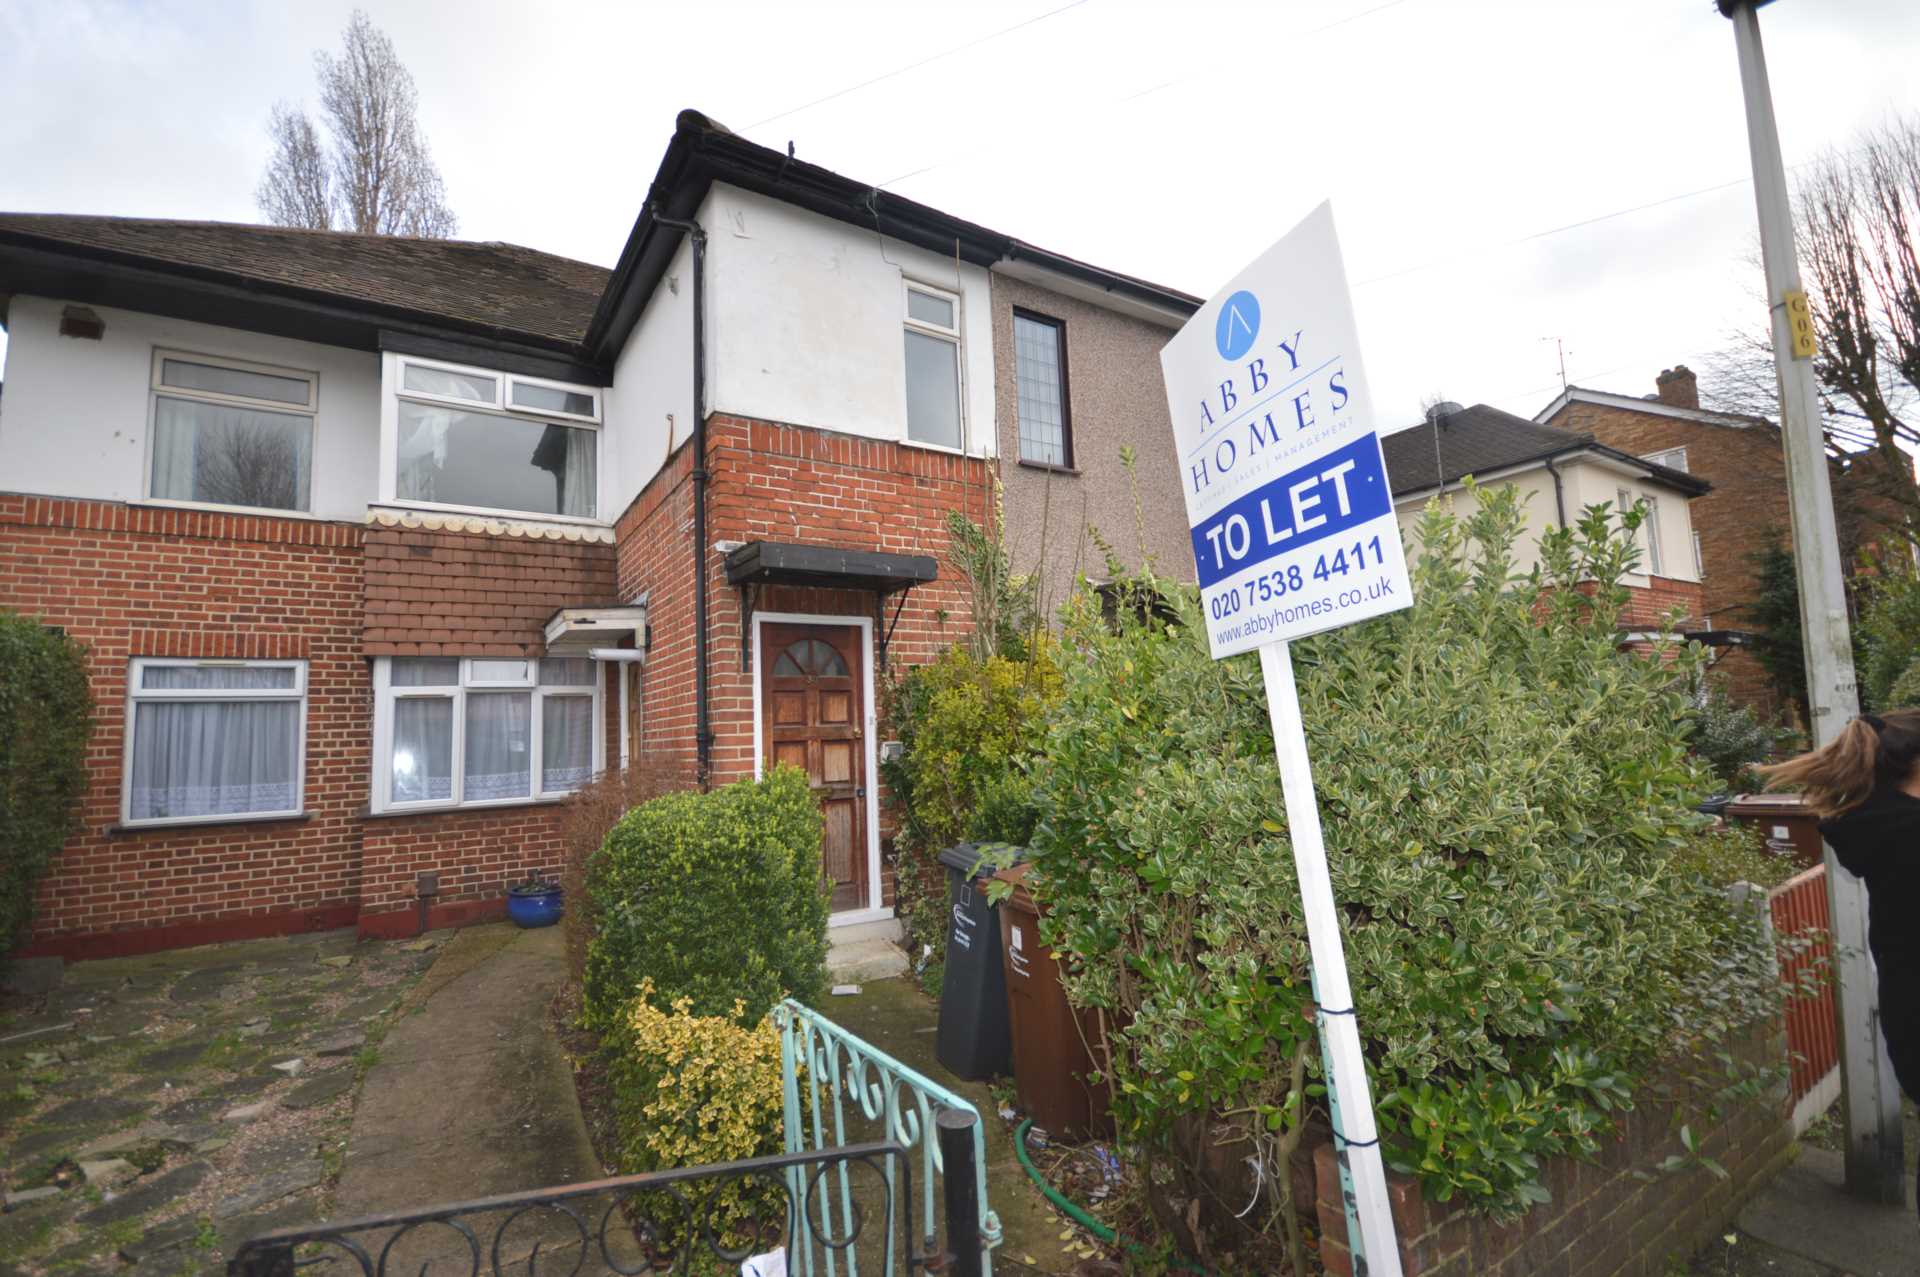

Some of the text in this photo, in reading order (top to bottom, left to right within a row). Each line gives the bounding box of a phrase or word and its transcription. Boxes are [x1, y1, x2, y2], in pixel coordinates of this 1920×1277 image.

[1191, 368, 1349, 495] HOMES
[1200, 329, 1304, 433] ABBY
[1206, 513, 1251, 570] TO
[1260, 458, 1356, 545] LET
[1211, 535, 1384, 620] 020 7538 4411
[1217, 576, 1395, 645] www.abbyhomes.co.uk
